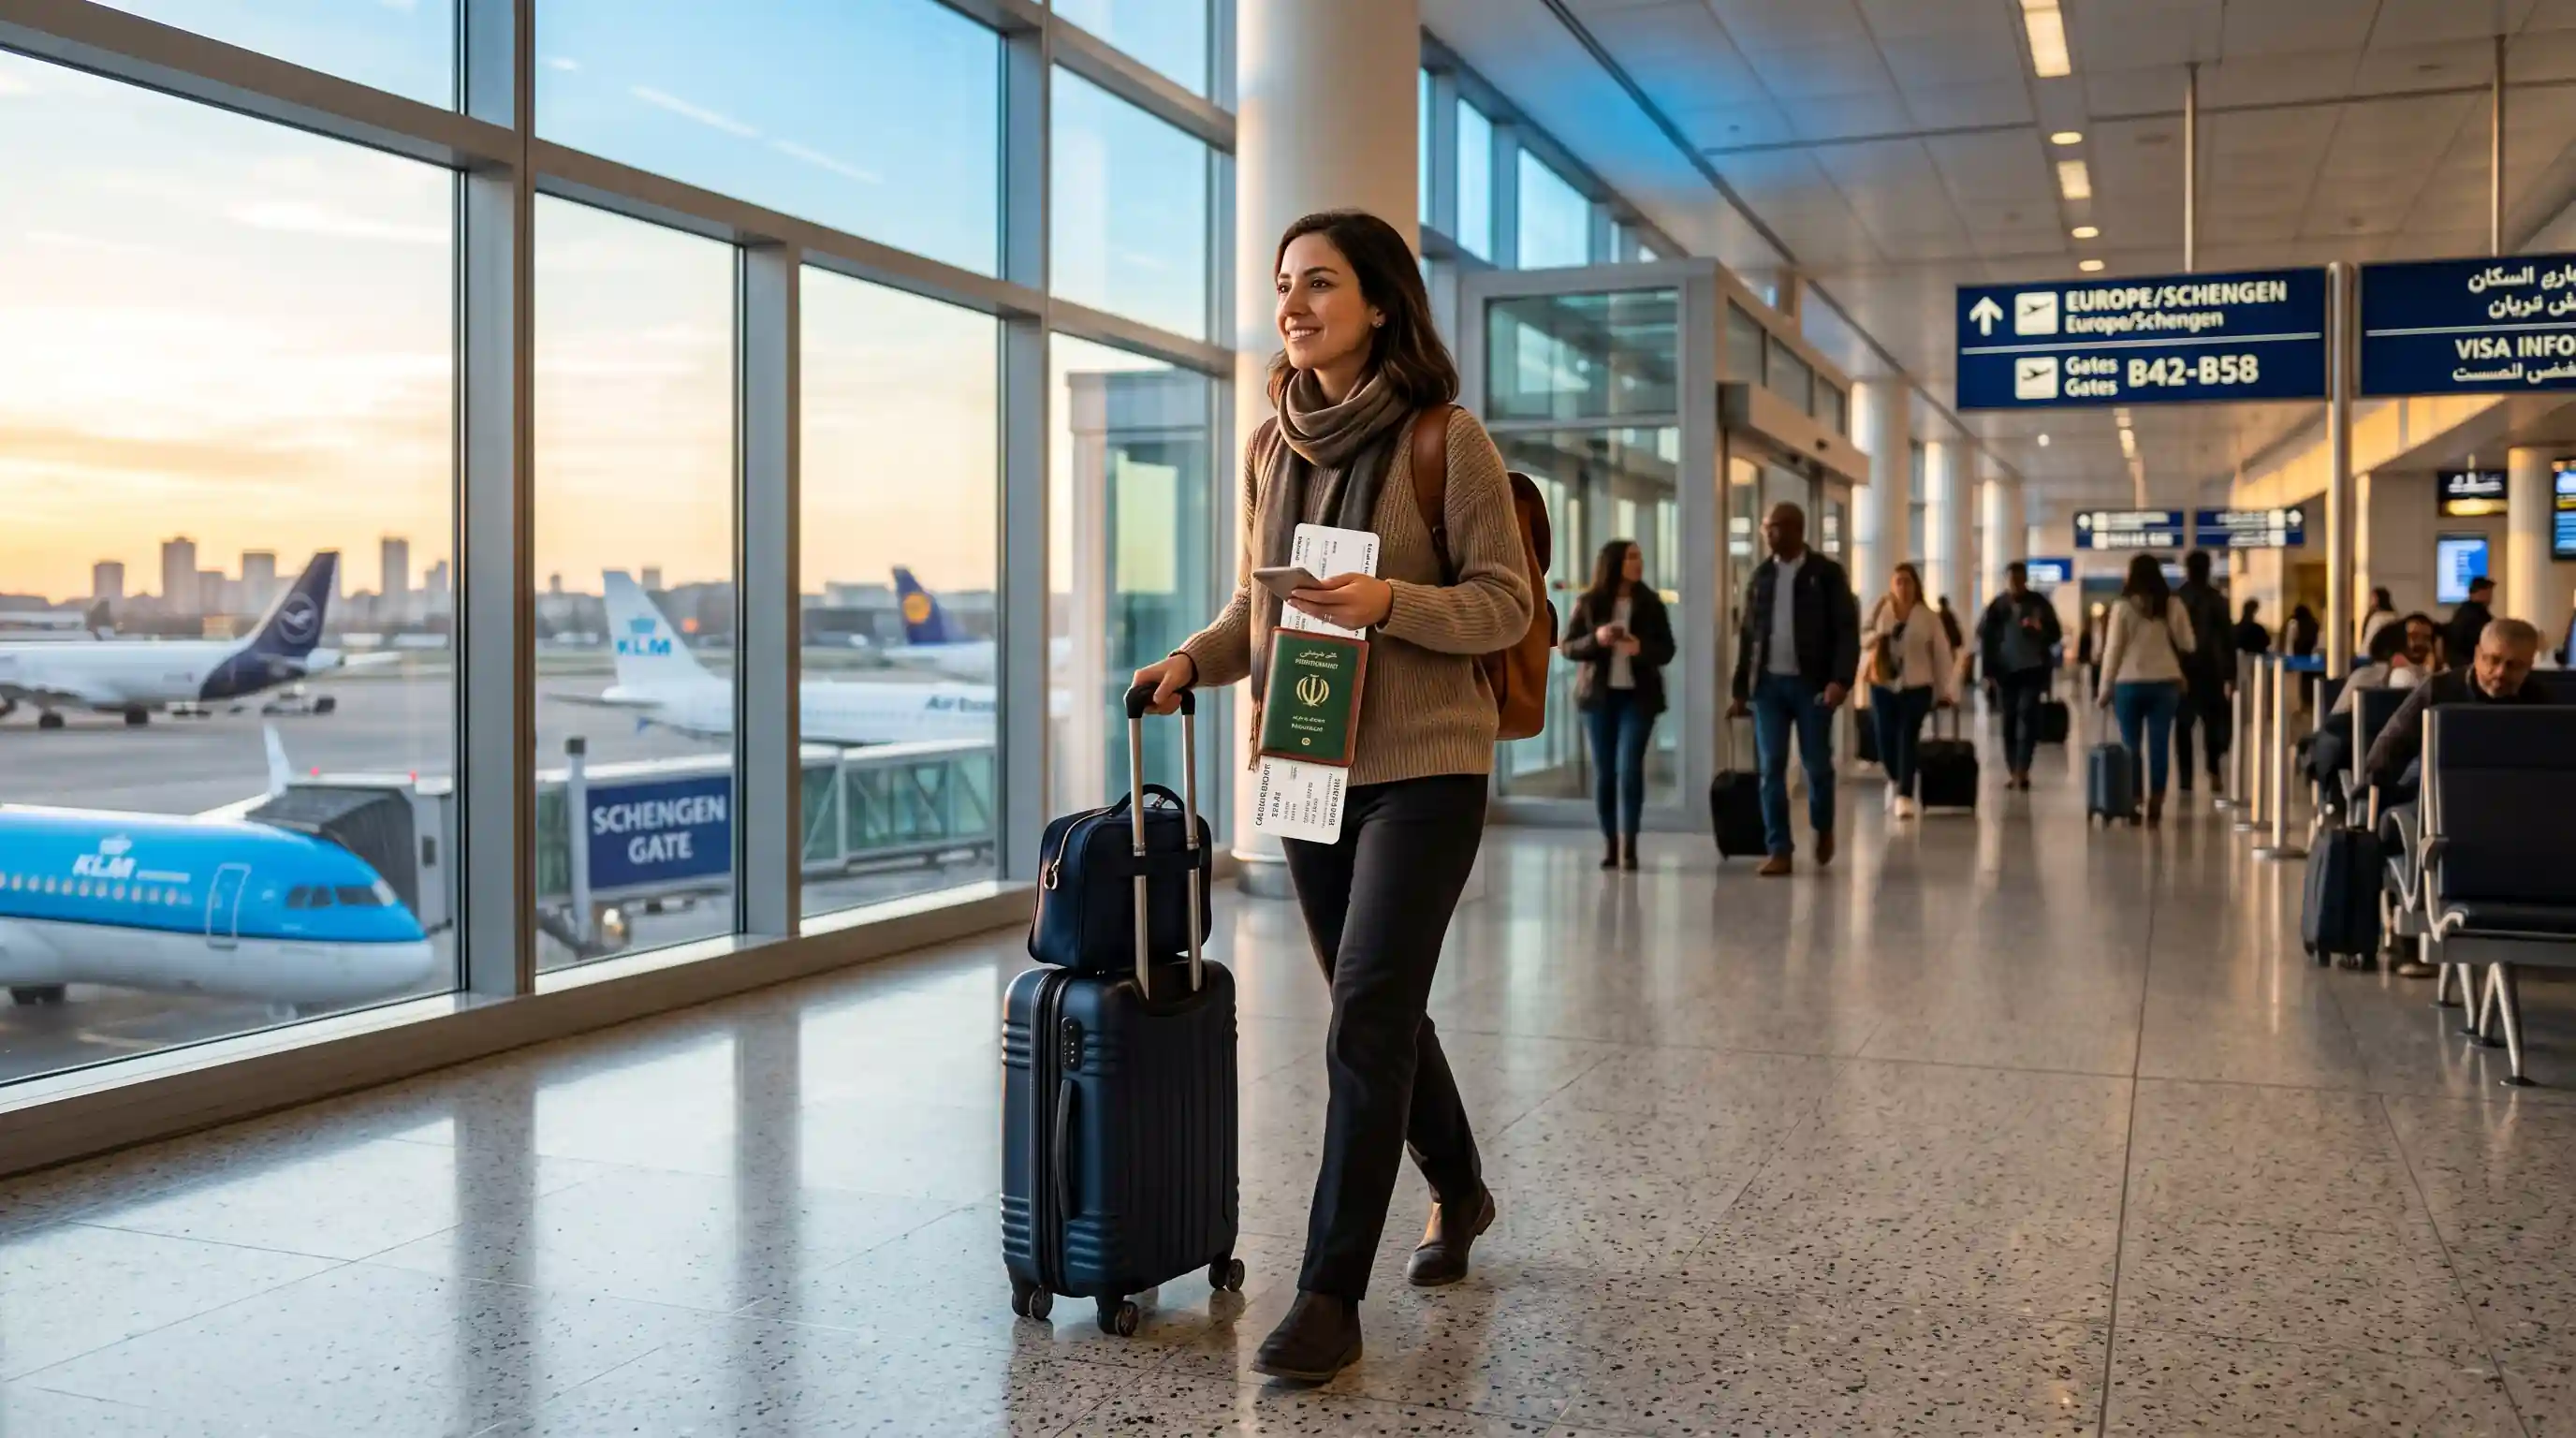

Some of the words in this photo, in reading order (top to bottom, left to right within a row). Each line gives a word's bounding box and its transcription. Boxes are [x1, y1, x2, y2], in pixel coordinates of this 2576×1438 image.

[2065, 281, 2287, 312] EUROPE/SCHENGEN
[2065, 311, 2225, 336] Europe/Schengen
[2454, 337, 2512, 360] VISA
[2517, 334, 2576, 357] INFO
[2065, 356, 2119, 376] Gates
[2128, 354, 2260, 388] B42-B58
[617, 638, 671, 655] KLM
[592, 795, 726, 835] SCHENGEN
[628, 830, 694, 865] GATE
[72, 854, 137, 879] KLM
